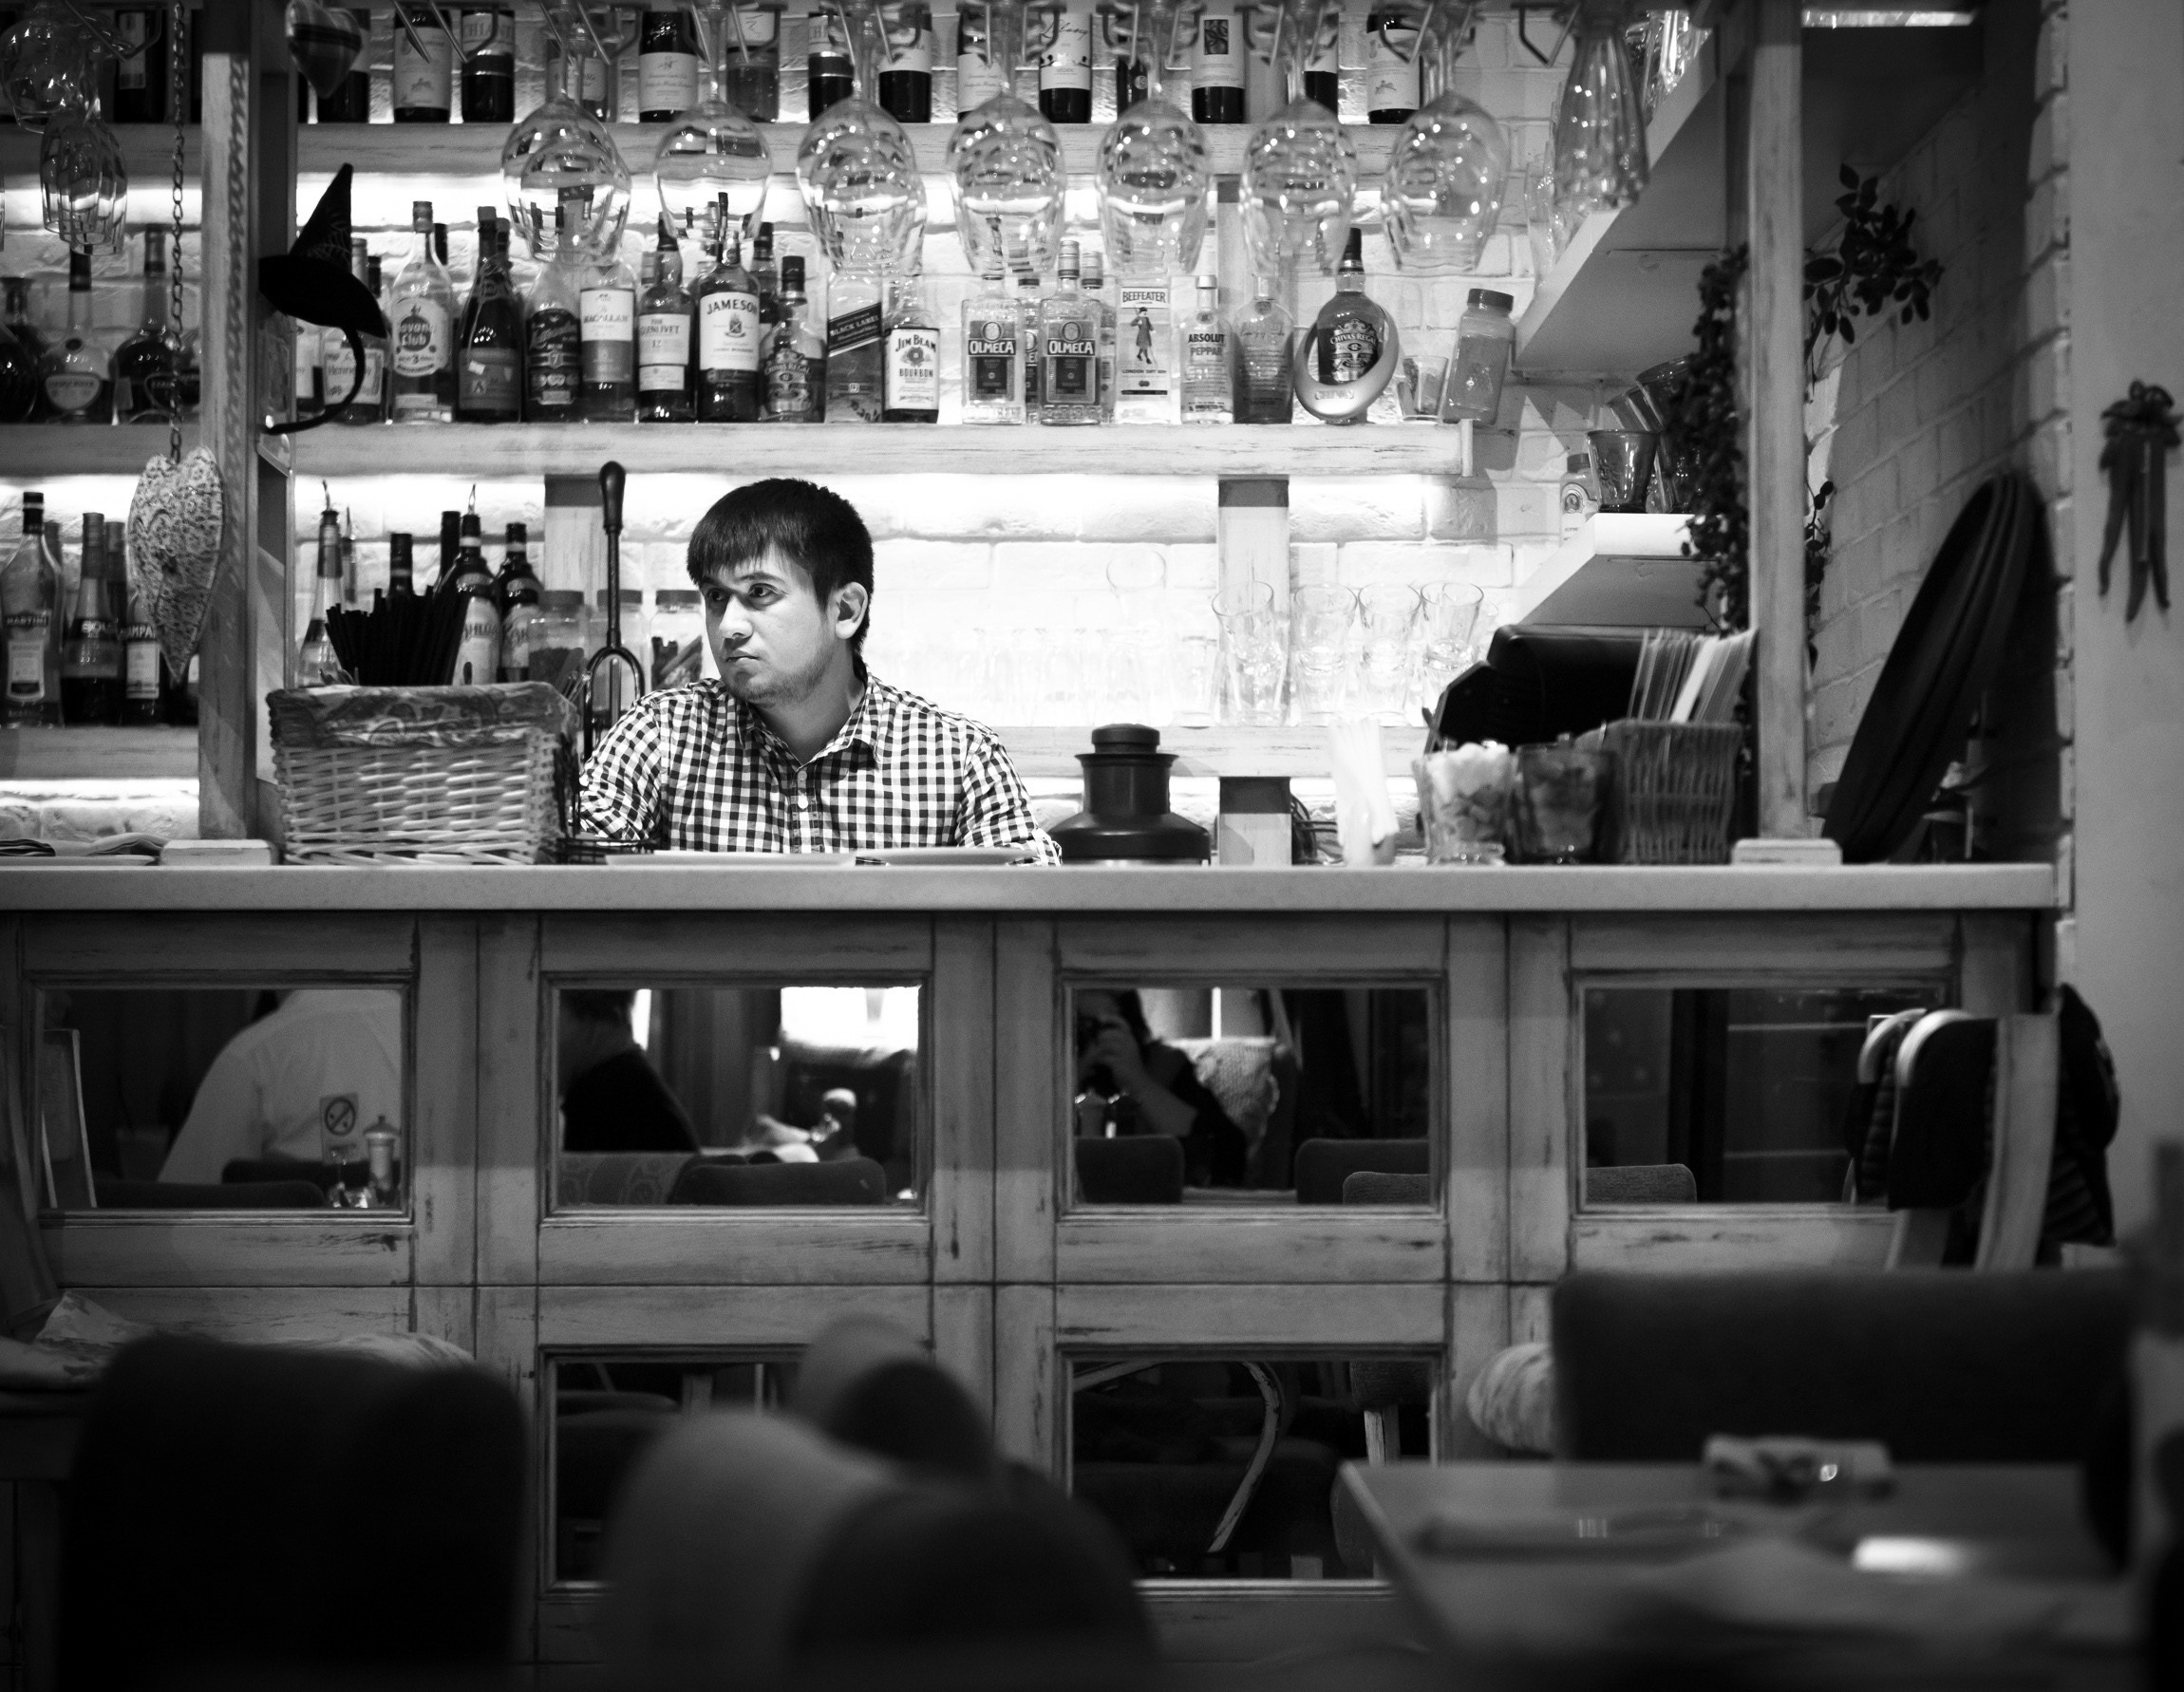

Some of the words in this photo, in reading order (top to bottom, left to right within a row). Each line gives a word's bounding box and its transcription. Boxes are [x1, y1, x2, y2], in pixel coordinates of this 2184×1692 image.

[1122, 291, 1165, 303] BEEFEATER
[707, 299, 757, 314] JAMESON
[830, 323, 855, 336] BLACK
[856, 315, 878, 328] LABEL
[401, 333, 427, 347] Club
[895, 337, 912, 351] JIM
[913, 334, 935, 352] BEAM
[1188, 333, 1225, 343] ABSOLUT
[1330, 333, 1355, 344] CHIVAS
[1356, 333, 1376, 344] REGAL
[970, 340, 1014, 354] OLMECA
[1048, 340, 1093, 354] OLMECA
[899, 368, 933, 378] BOURBON
